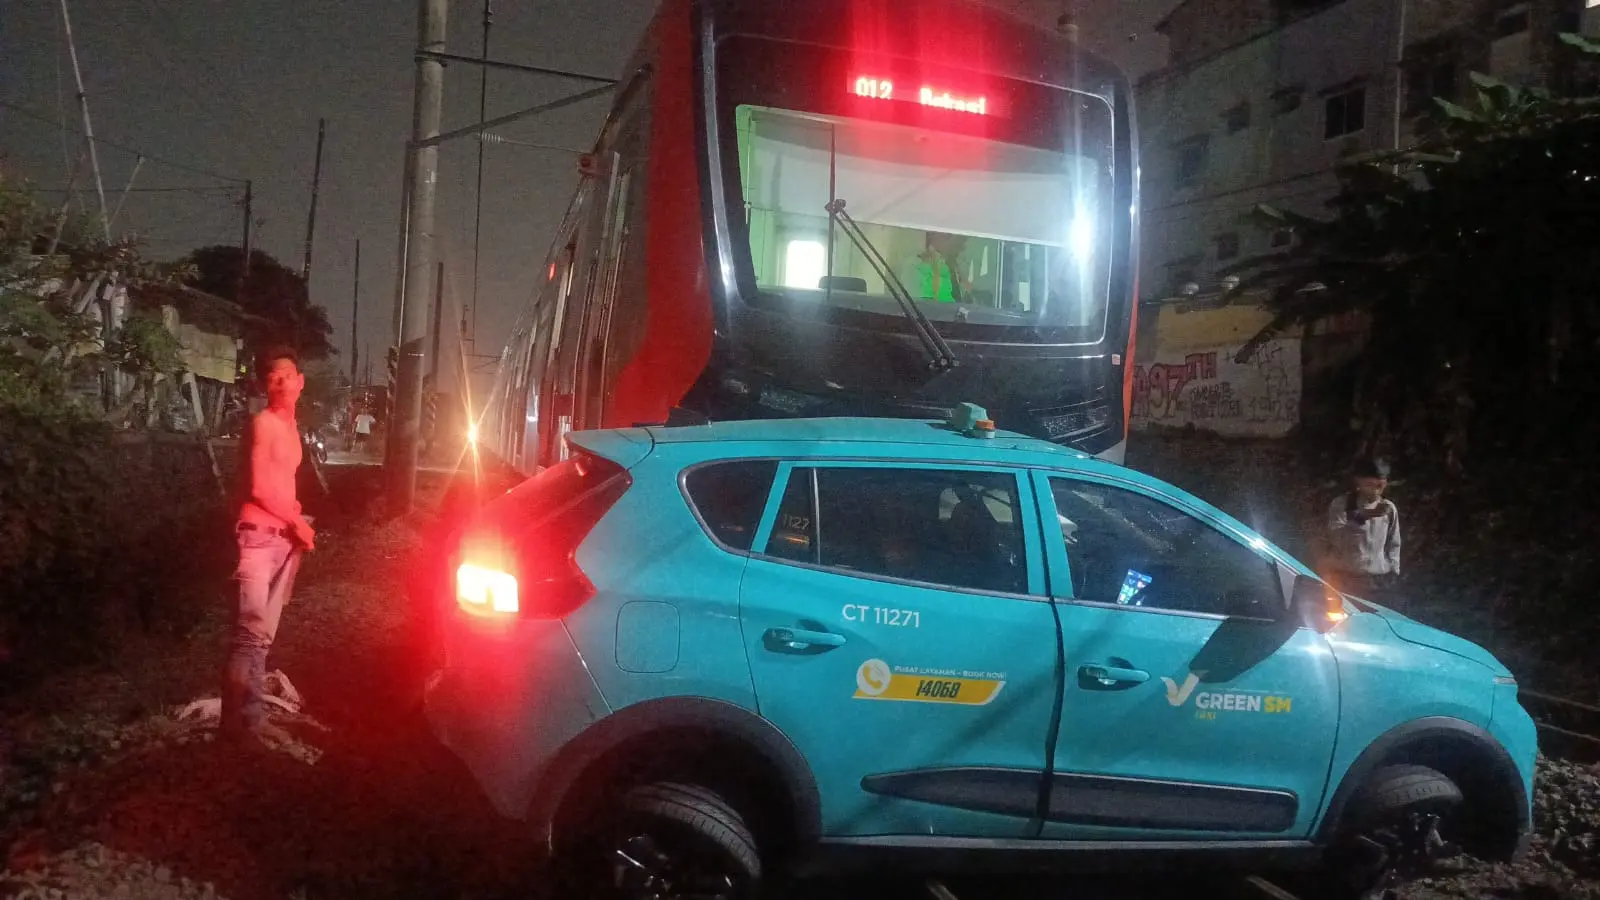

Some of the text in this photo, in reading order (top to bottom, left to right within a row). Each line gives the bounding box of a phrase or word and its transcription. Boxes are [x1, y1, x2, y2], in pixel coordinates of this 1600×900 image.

[855, 78, 892, 100] 012
[842, 604, 920, 628] CT 11271
[894, 665, 919, 673] PUSAT
[920, 667, 956, 676] LAYANAN
[963, 670, 984, 678] BOOK
[916, 680, 961, 699] 14068
[1195, 692, 1292, 713] GREEN SM
